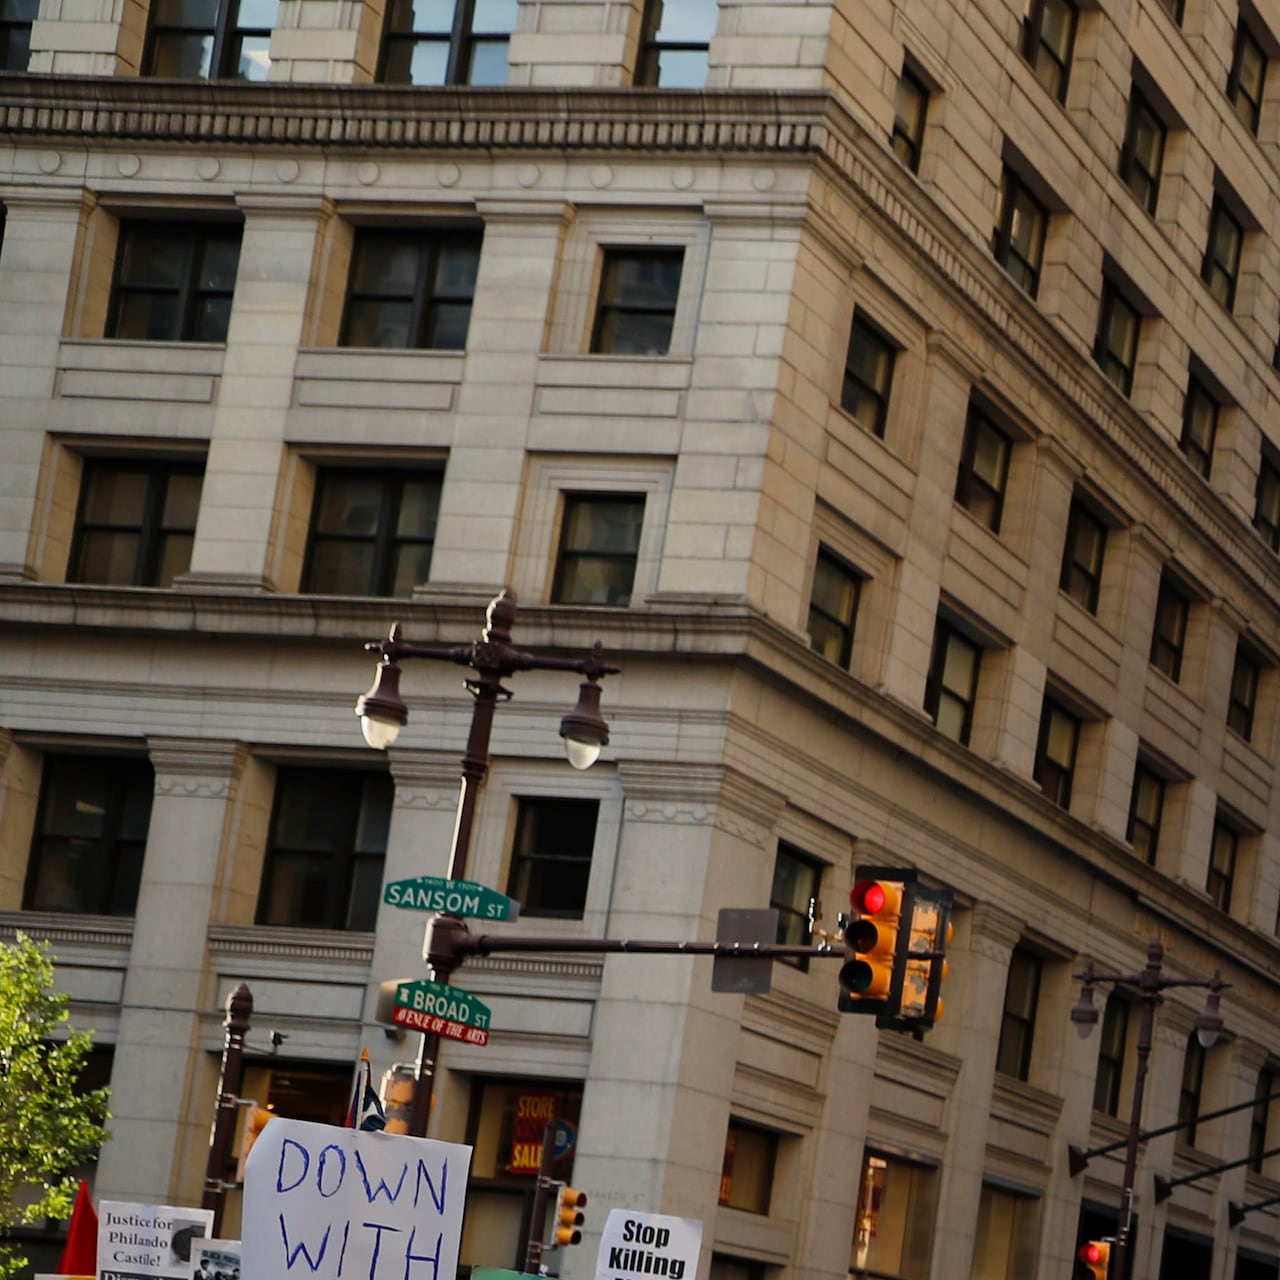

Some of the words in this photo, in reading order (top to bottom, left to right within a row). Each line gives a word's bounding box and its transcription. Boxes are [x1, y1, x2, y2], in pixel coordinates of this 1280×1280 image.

[387, 885, 480, 915] SANSOM
[487, 904, 504, 919] ST
[413, 990, 469, 1022] BROAD
[475, 1014, 488, 1029] ST
[432, 1017, 446, 1033] OF
[445, 1022, 464, 1038] THE
[466, 1029, 488, 1044] ARTS
[518, 1096, 555, 1118] STORE
[277, 1138, 448, 1215] DOWN
[106, 1212, 150, 1229] Justice
[152, 1215, 173, 1230] for
[622, 1220, 670, 1248] Stop
[108, 1231, 168, 1249] Philando
[113, 1251, 161, 1267] Castile!
[609, 1247, 686, 1280] Killing
